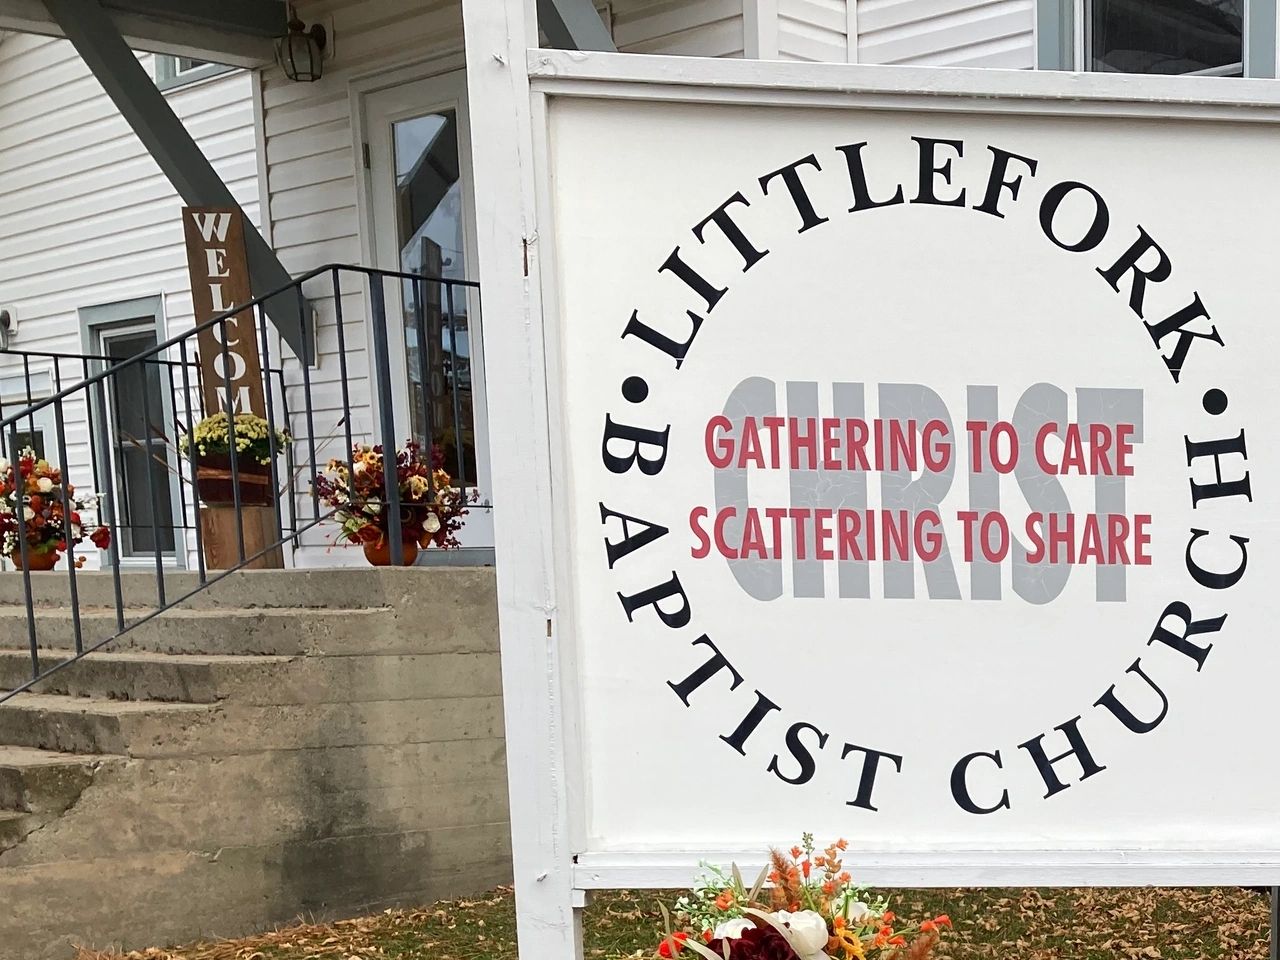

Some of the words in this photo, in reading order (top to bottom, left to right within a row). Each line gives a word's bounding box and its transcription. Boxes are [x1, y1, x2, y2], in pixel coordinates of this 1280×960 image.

[191, 212, 254, 415] WELCOM
[620, 136, 1225, 383] LITTLEFORK
[689, 506, 943, 562] SCATTERING
[957, 511, 1009, 564] TO
[1025, 512, 1153, 566] SHARE
[704, 415, 951, 474] GATHERING
[966, 421, 1019, 474] TO
[1035, 422, 1135, 476] CARE
[713, 376, 1144, 605] CHRIST
[599, 412, 903, 813] BAPTIST
[949, 428, 1254, 815] CHURCH
